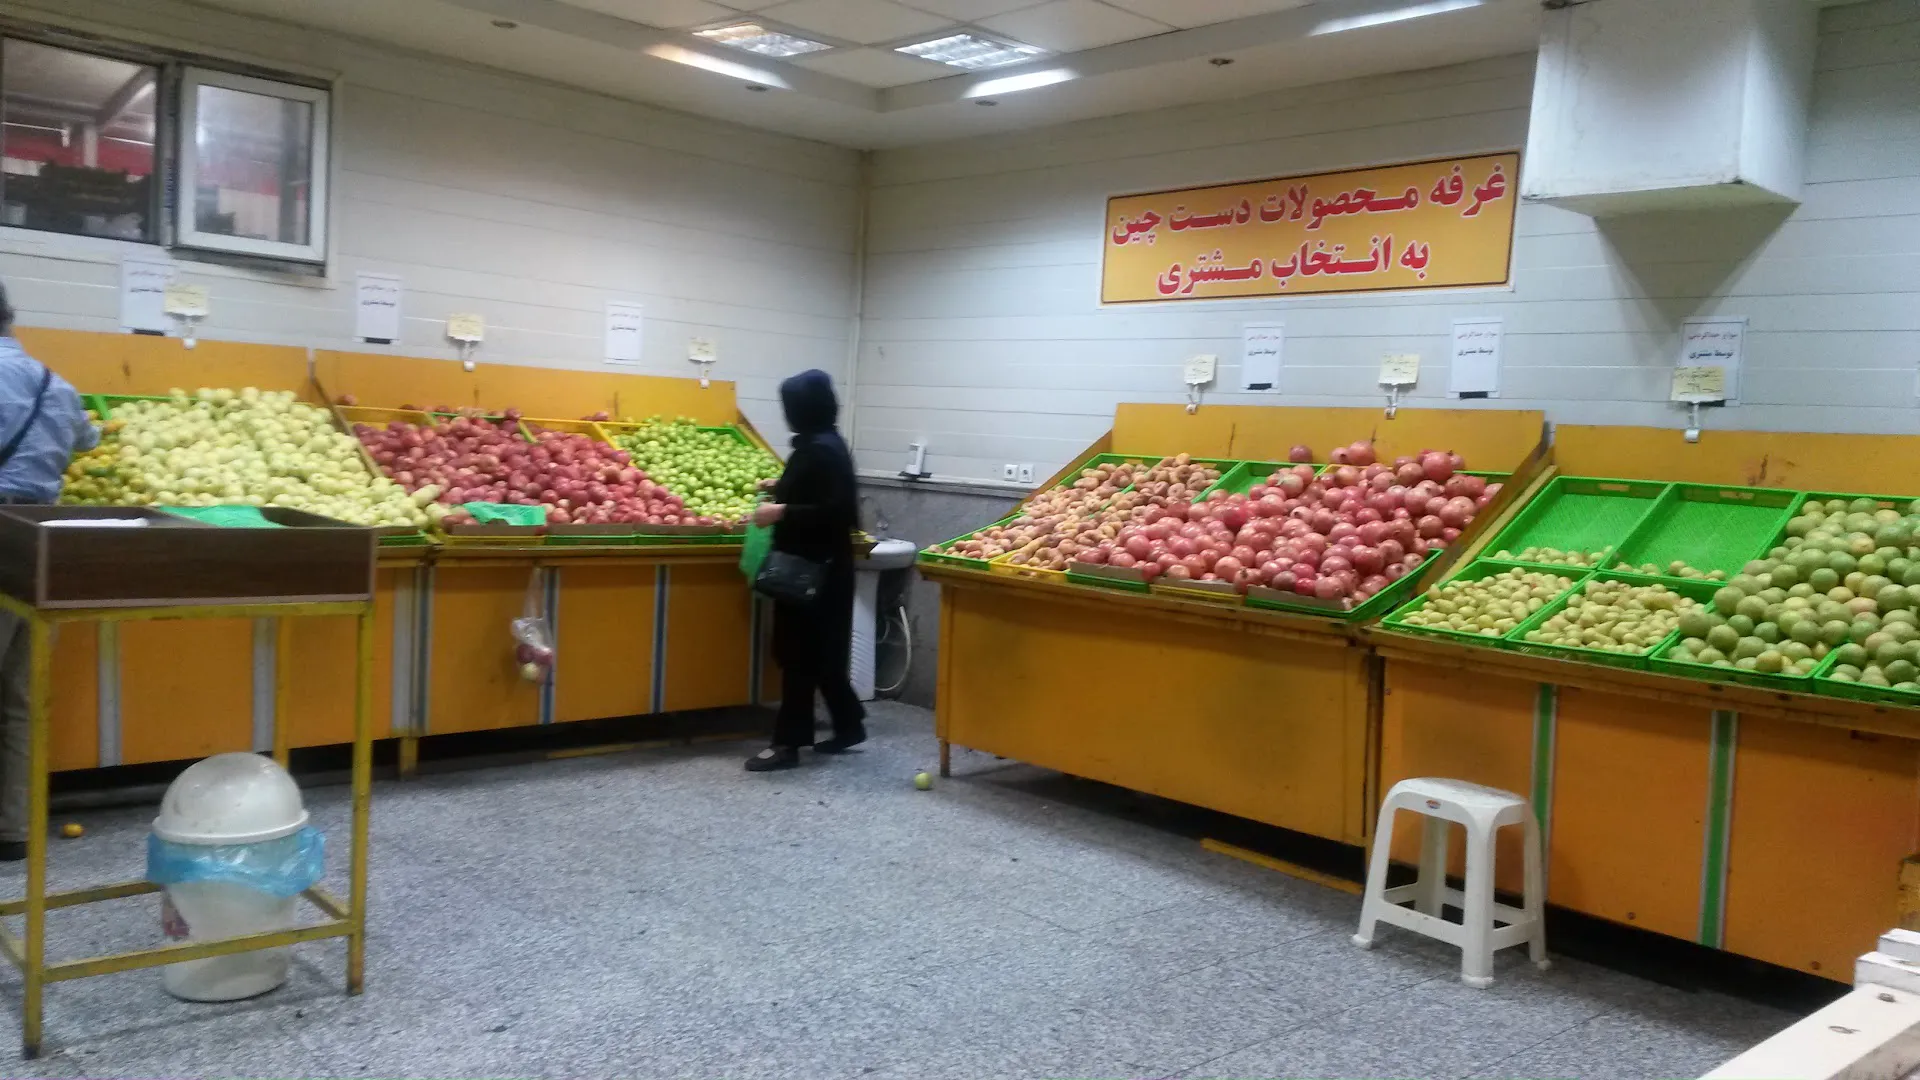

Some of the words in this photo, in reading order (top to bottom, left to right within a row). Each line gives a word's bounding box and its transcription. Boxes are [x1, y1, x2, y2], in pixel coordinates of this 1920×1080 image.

[1259, 183, 1418, 231] محصولات
[1429, 163, 1506, 217] غرفه
[1112, 208, 1161, 244] چین
[1169, 203, 1251, 232] دست
[1158, 248, 1262, 294] مشتری
[1271, 235, 1392, 286] انتخاب
[1400, 239, 1430, 280] به
